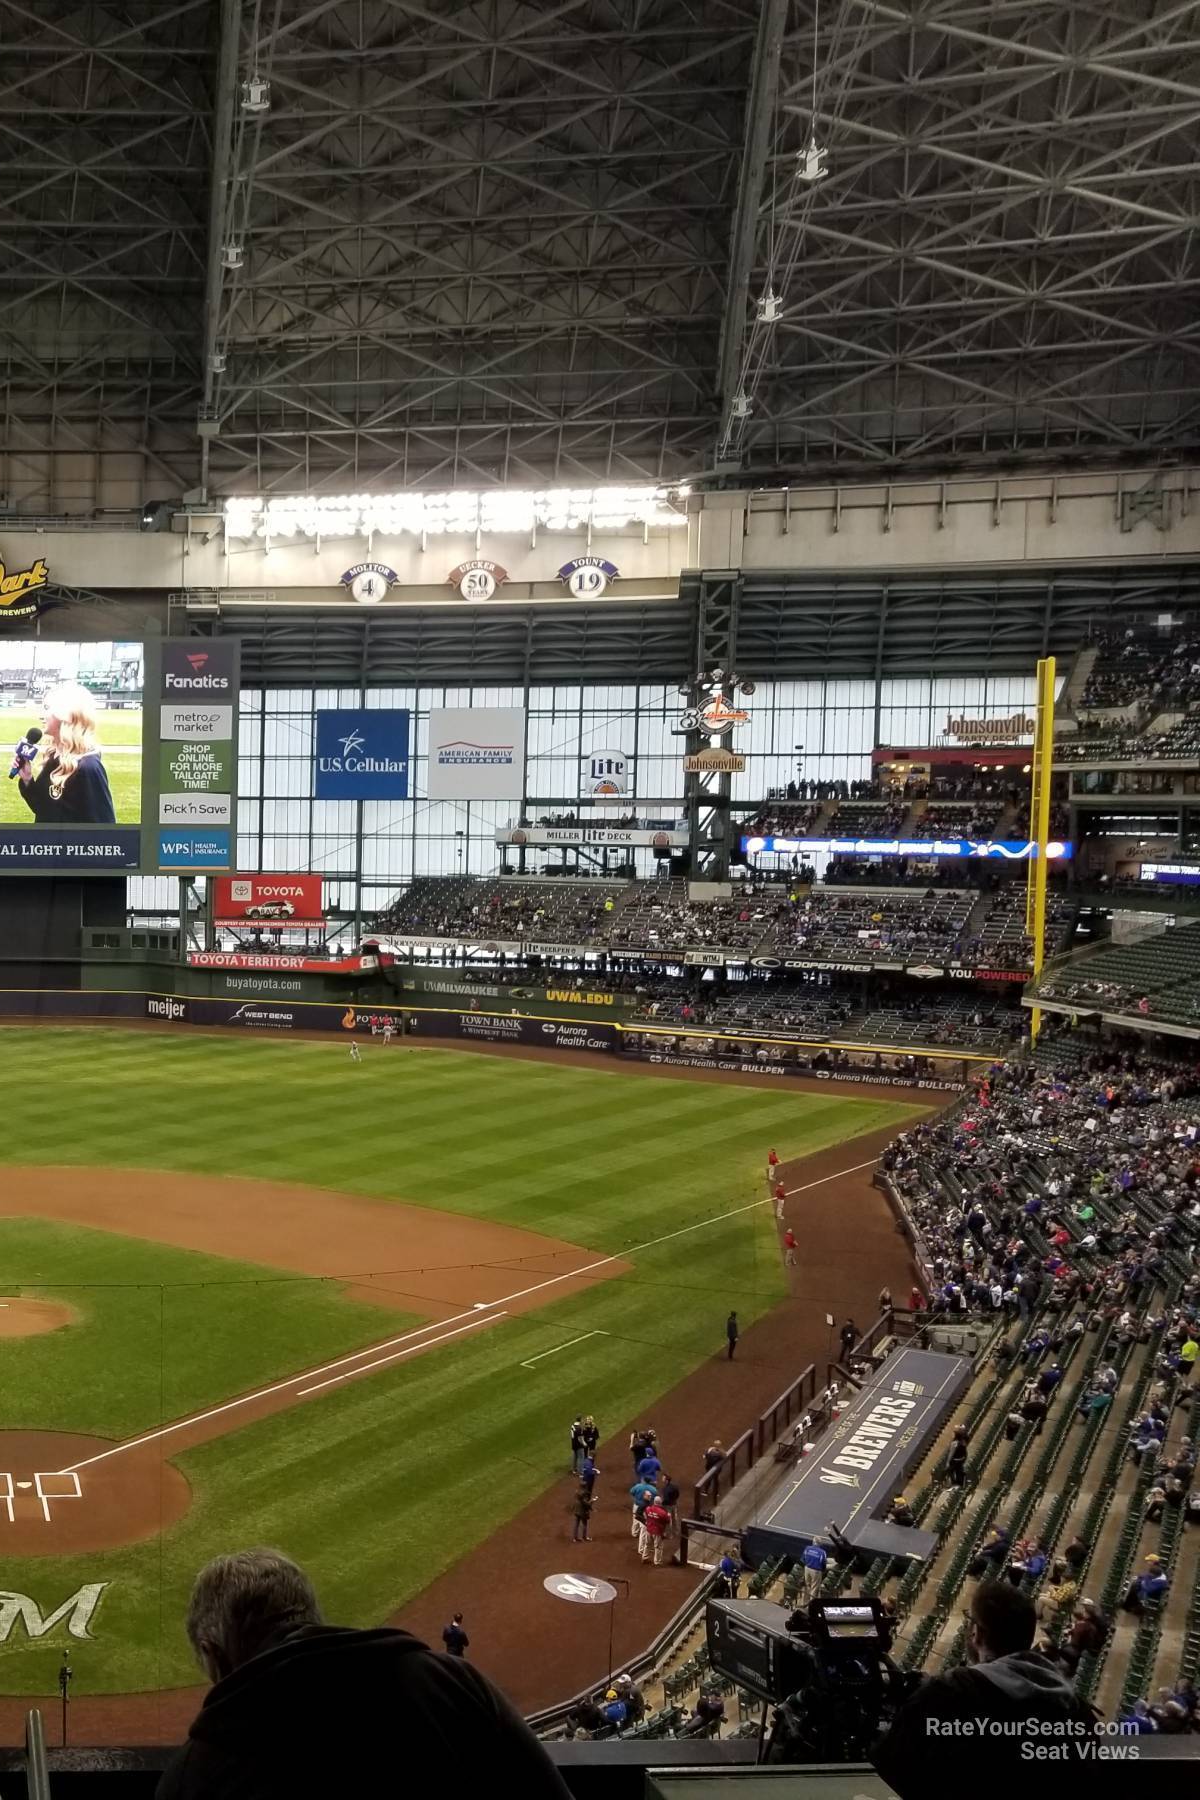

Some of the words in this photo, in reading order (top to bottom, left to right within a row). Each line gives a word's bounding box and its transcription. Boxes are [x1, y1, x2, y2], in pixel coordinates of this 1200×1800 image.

[349, 563, 390, 576] MOLITOR
[458, 560, 496, 573] UECKER
[572, 558, 605, 569] YOUNT
[361, 578, 374, 597] 4
[467, 574, 488, 590] 50
[576, 573, 602, 592] 19
[165, 674, 228, 688] Fanatics
[174, 712, 208, 722] metro
[174, 722, 214, 732] market
[942, 714, 1034, 736] Johnsonville
[182, 744, 210, 754] SHOP
[178, 754, 215, 763] ONLINE
[686, 757, 743, 770] Johnsonville
[169, 762, 190, 771] FOR
[192, 762, 222, 772] MORE
[319, 758, 343, 772] U.S.
[345, 758, 406, 773] Cellular
[590, 758, 624, 779] Lite
[172, 771, 220, 780] TAILGATE
[182, 780, 210, 789] TIME!
[164, 804, 187, 814] Pick
[199, 804, 227, 814] Save
[546, 832, 580, 840] MILLER
[607, 832, 632, 840] DECK
[21, 844, 62, 856] LIGHT
[66, 845, 125, 856] PILSNER.
[162, 843, 189, 854] WPS
[256, 886, 304, 897] TOYOTA
[192, 954, 238, 967] TOYOTA
[241, 956, 305, 968] TERRITORY
[226, 976, 301, 991] buyatoyota.com
[546, 990, 614, 1006] UWM.EDU
[148, 998, 185, 1018] meijer
[460, 1015, 490, 1026] TOWN
[492, 1018, 522, 1030] BANK
[468, 1027, 500, 1036] WINTRUST
[501, 1030, 519, 1038] BANK
[558, 1024, 588, 1036] Aurora
[556, 1036, 585, 1048] Health
[587, 1039, 608, 1049] Care
[663, 1055, 690, 1066] Aurora
[691, 1058, 717, 1068] Health
[718, 1060, 736, 1070] Care
[741, 1064, 785, 1075] BULLPEN
[831, 1072, 861, 1082] Aurora
[862, 1073, 891, 1084] Health
[892, 1077, 912, 1087] Care
[918, 1080, 966, 1092] BULLPEN
[832, 1396, 916, 1471] BREWERS
[714, 1620, 720, 1637] 2
